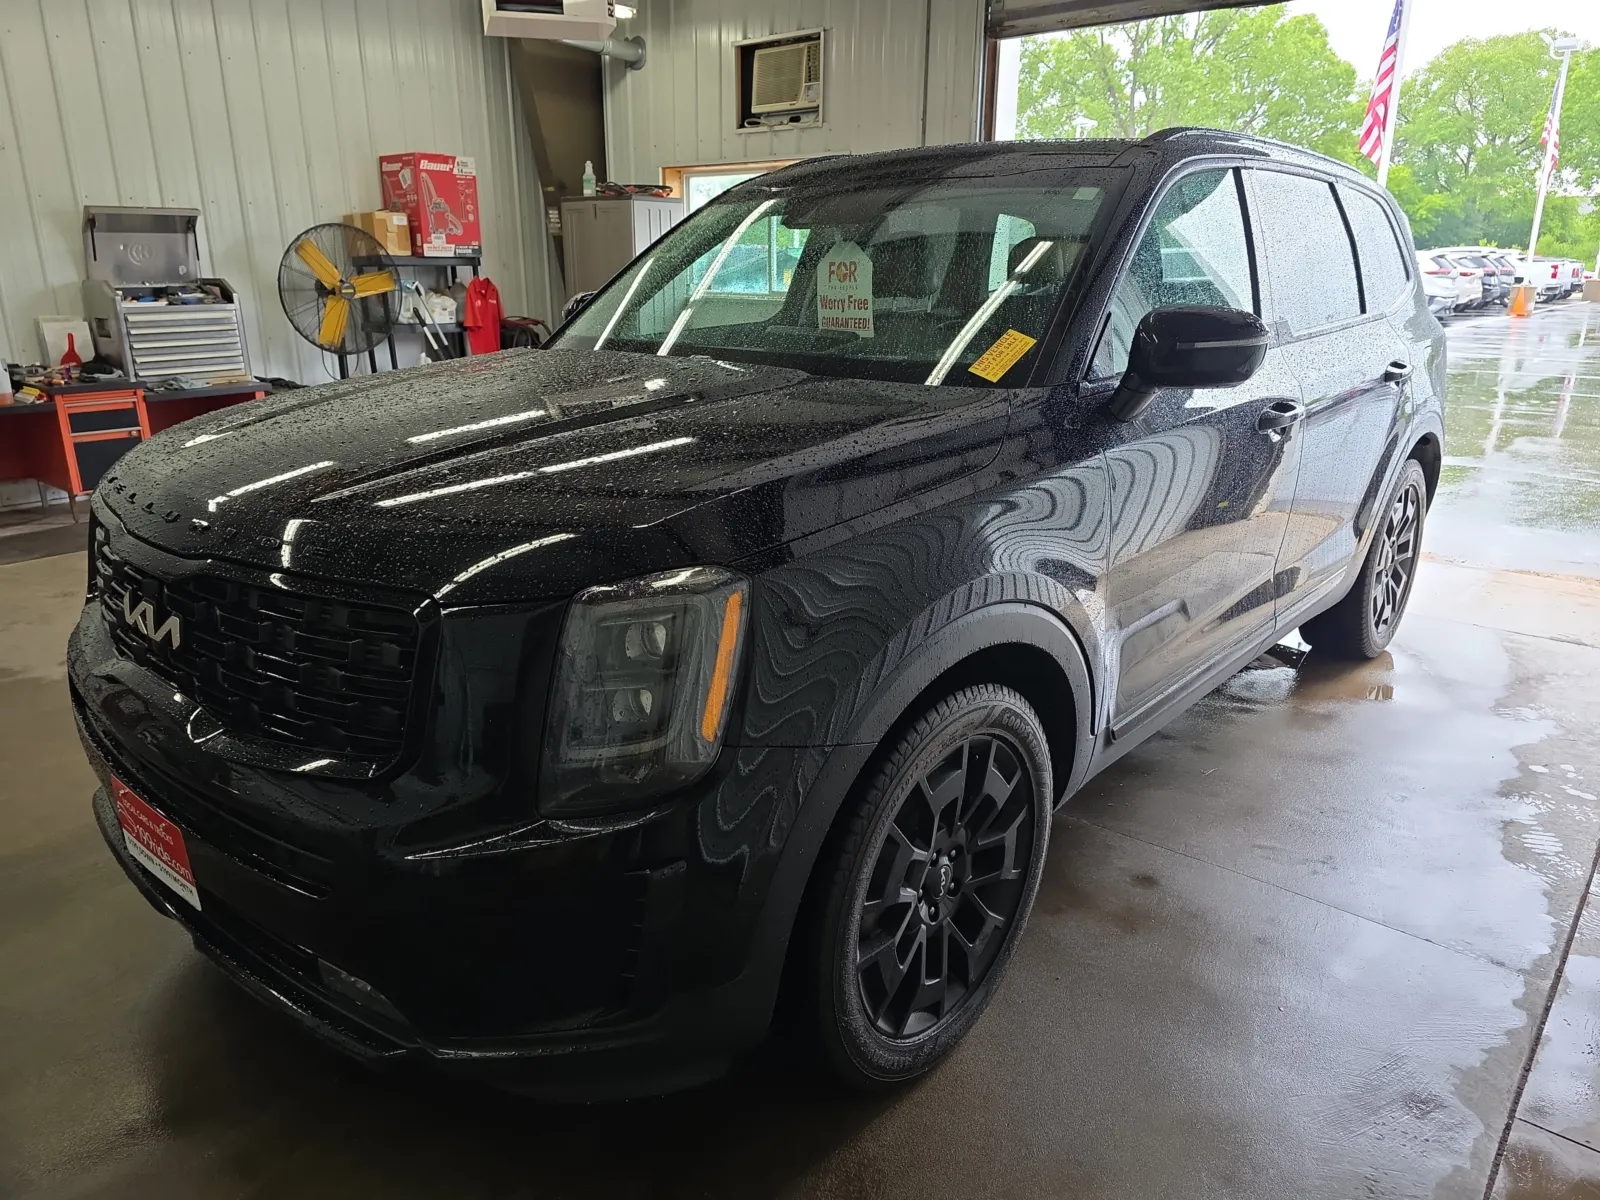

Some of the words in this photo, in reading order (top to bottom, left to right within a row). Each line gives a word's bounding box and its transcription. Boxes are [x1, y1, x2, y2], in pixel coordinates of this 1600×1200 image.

[420, 159, 454, 172] Bauer
[828, 260, 858, 284] FOR
[820, 294, 846, 313] Worry
[847, 294, 869, 311] Free
[821, 316, 871, 330] GUARANTEED!
[972, 356, 989, 371] THIS
[986, 331, 1014, 356] VEHICLE
[980, 361, 993, 373] NOT
[991, 349, 1006, 362] FOR
[1003, 336, 1020, 351] SALE
